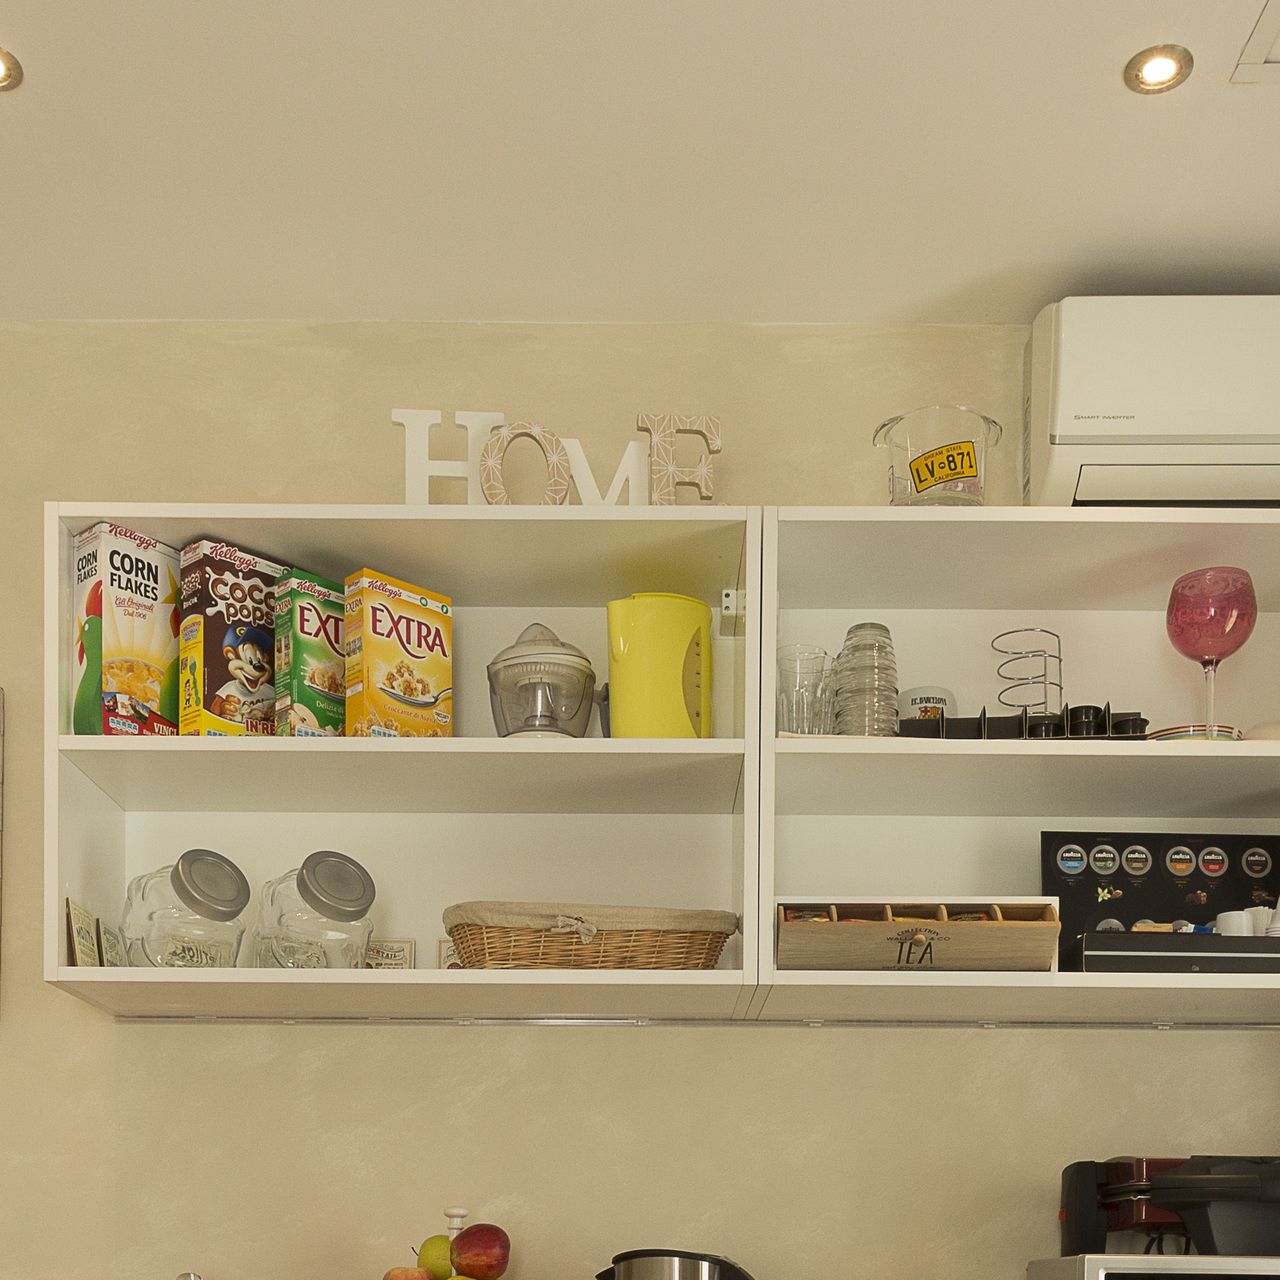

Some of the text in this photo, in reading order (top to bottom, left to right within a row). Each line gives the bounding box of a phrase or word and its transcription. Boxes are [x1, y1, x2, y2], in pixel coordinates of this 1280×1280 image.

[391, 408, 721, 506] HOME
[933, 471, 966, 482] CALIFORNIA
[77, 549, 98, 573] CORN
[109, 550, 159, 585] CORN
[209, 543, 258, 570] Kellogg's
[77, 565, 98, 585] FLAKES
[110, 572, 158, 601] FLAKES
[296, 580, 332, 600] Kellogg's
[368, 580, 402, 598] Kellogg's
[298, 602, 346, 658] EXT
[371, 602, 448, 659] EXTRA
[897, 941, 934, 964] TEA
